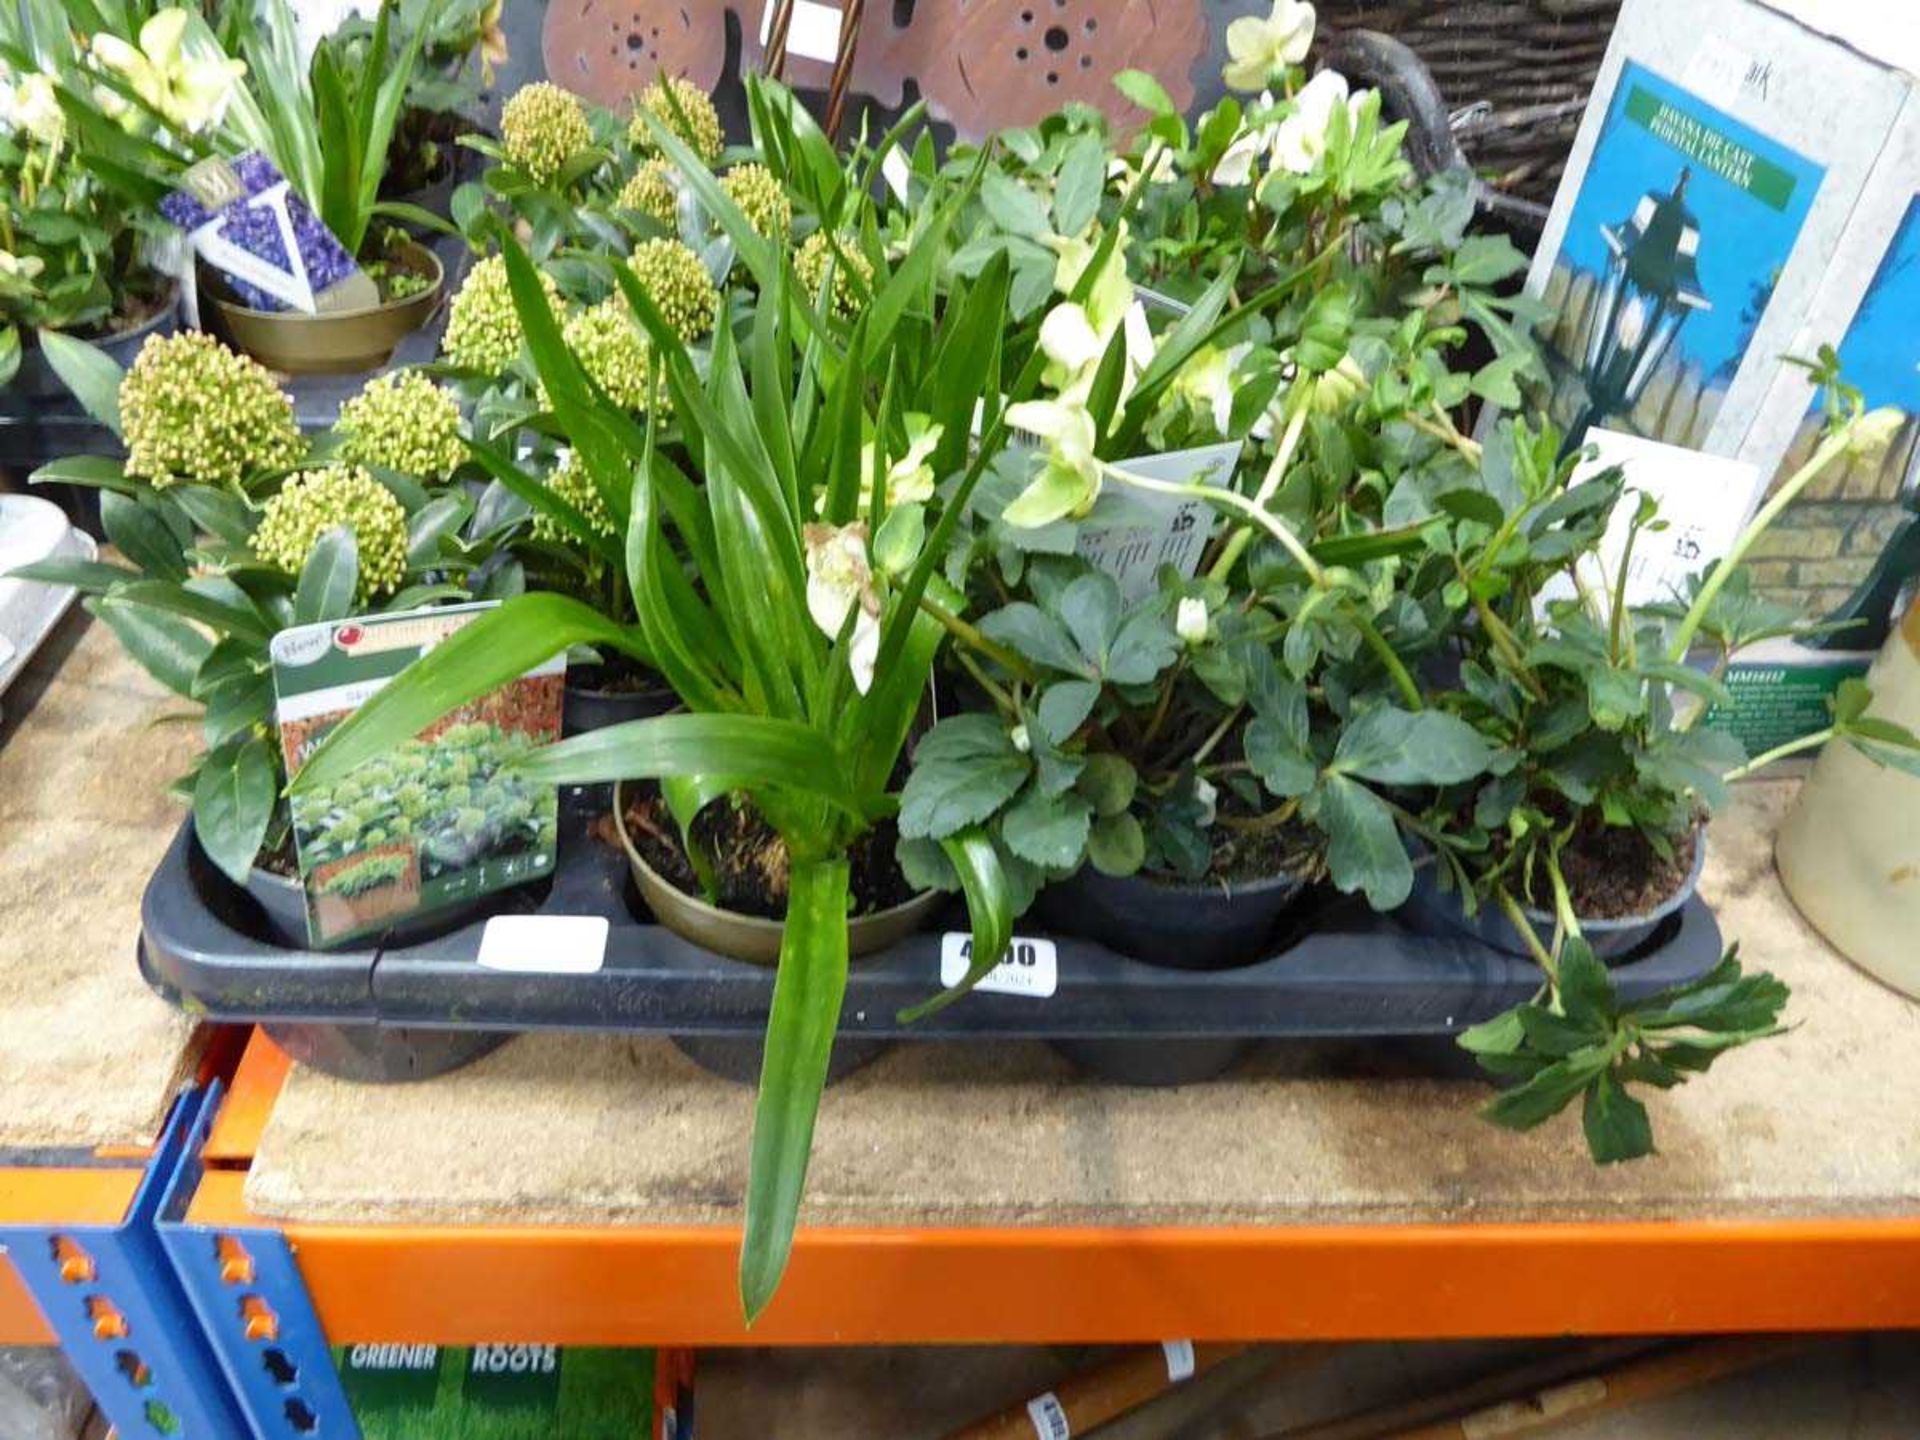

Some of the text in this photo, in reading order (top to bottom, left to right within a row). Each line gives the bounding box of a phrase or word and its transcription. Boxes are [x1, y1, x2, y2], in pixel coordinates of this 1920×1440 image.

[1698, 146, 1752, 189] LANTERN
[960, 940, 1036, 967] 400
[351, 1343, 437, 1369] GREENER
[472, 1343, 556, 1373] ROOTS
